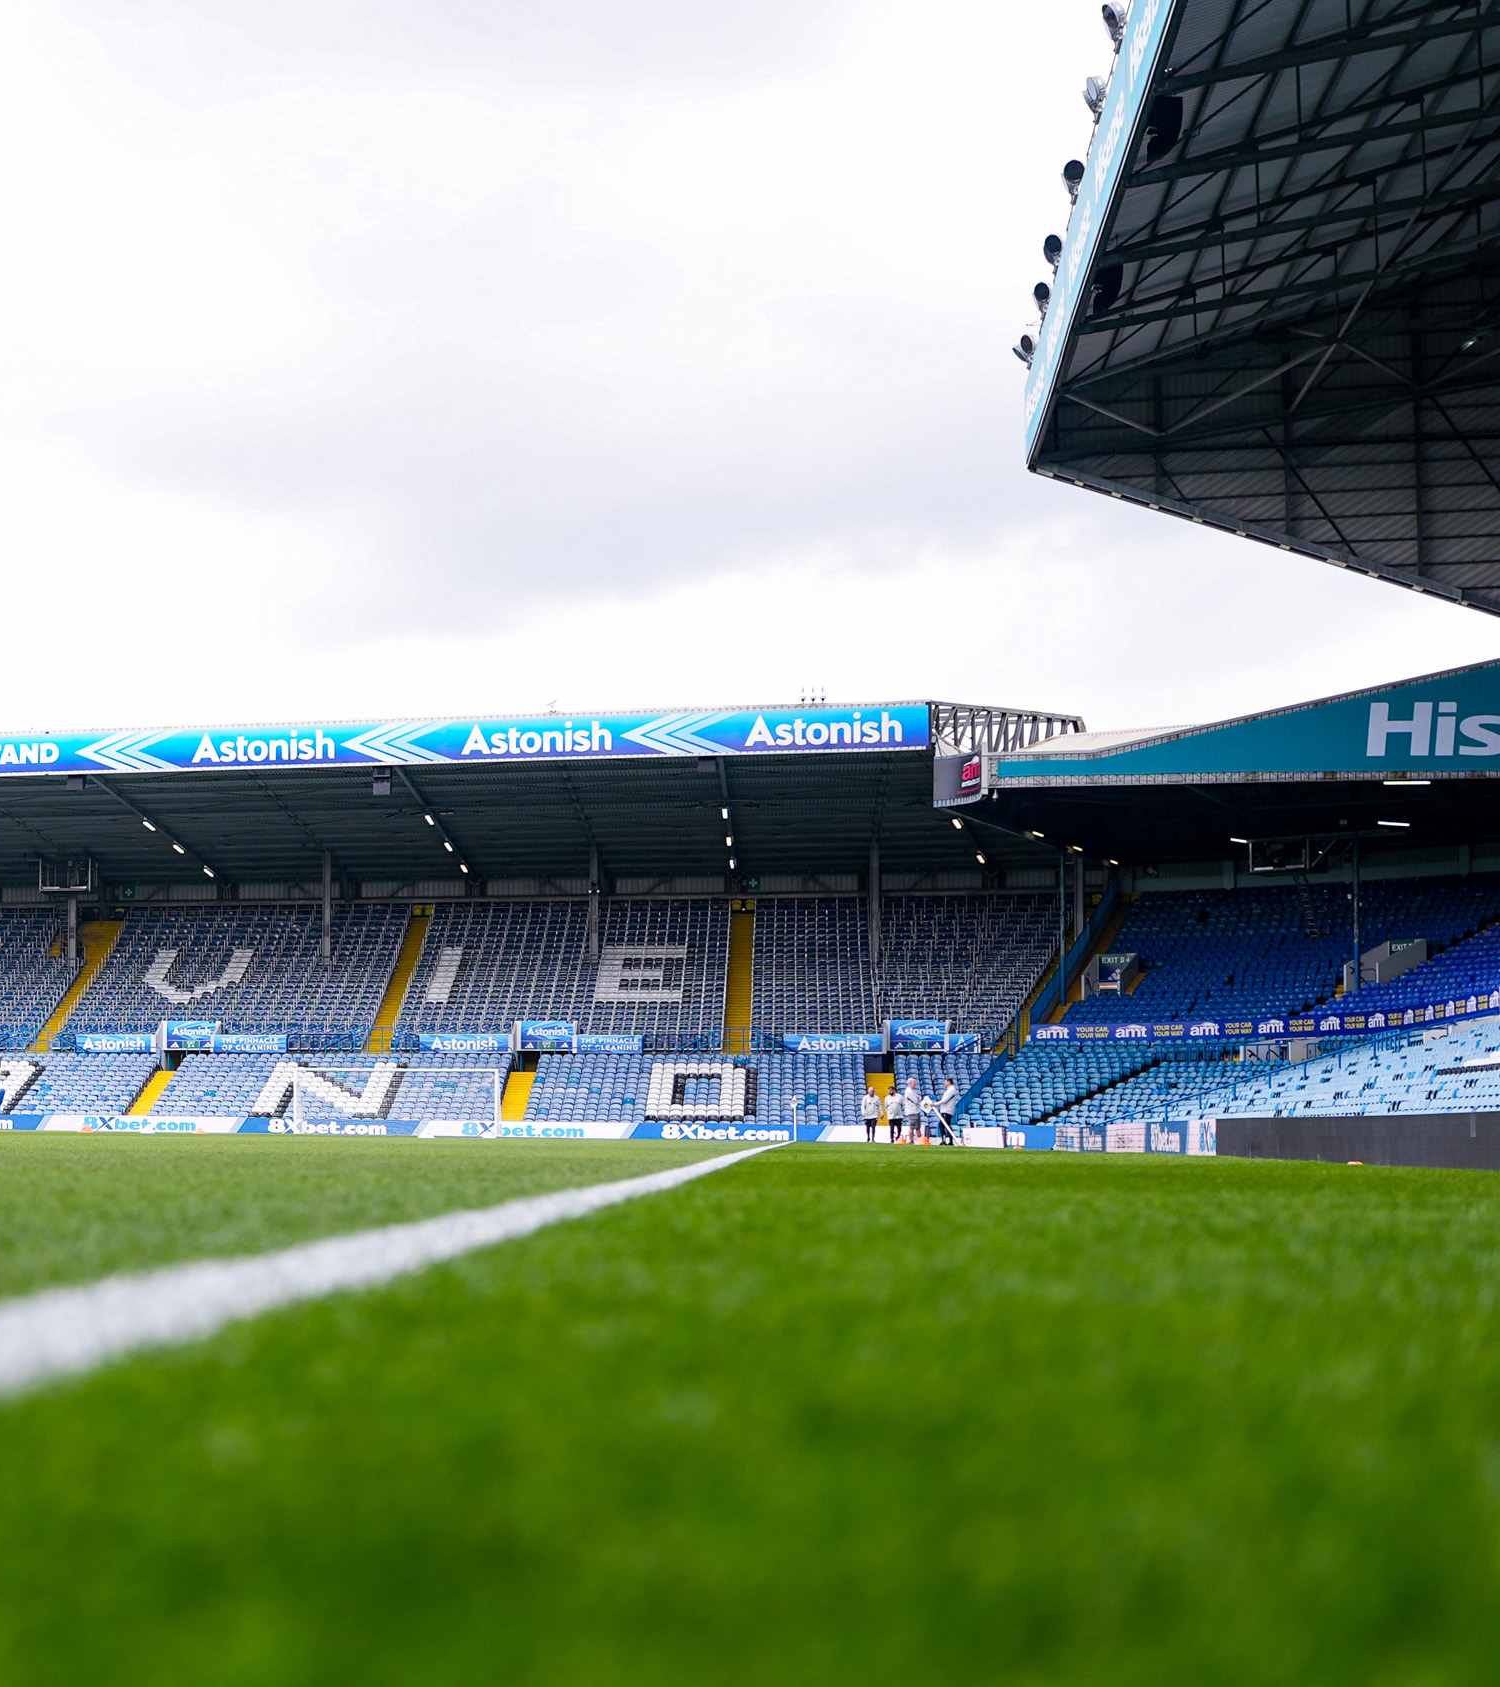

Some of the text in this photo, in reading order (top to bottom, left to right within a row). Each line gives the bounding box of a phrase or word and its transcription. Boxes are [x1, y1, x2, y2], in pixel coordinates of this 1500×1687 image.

[744, 711, 903, 748] Astonish
[460, 720, 612, 756] Astonish
[191, 729, 335, 763] Astonish
[172, 1026, 211, 1036] Astonish
[896, 1026, 940, 1035] Astonish
[1190, 1022, 1219, 1036] amt
[1258, 1019, 1284, 1034] amt
[1320, 1016, 1340, 1031] amt
[526, 1027, 568, 1036] Astonish
[1036, 1026, 1069, 1039] amt
[1115, 1025, 1147, 1038] amt
[83, 1036, 146, 1050] Astonish
[431, 1036, 498, 1051] Astonish
[797, 1036, 869, 1050] Astonish
[83, 1116, 196, 1132] 8Xbet.com
[267, 1118, 387, 1135] 8Xbet.com
[462, 1122, 584, 1138] 8Xbet.com
[661, 1124, 789, 1141] 8Xbet.com
